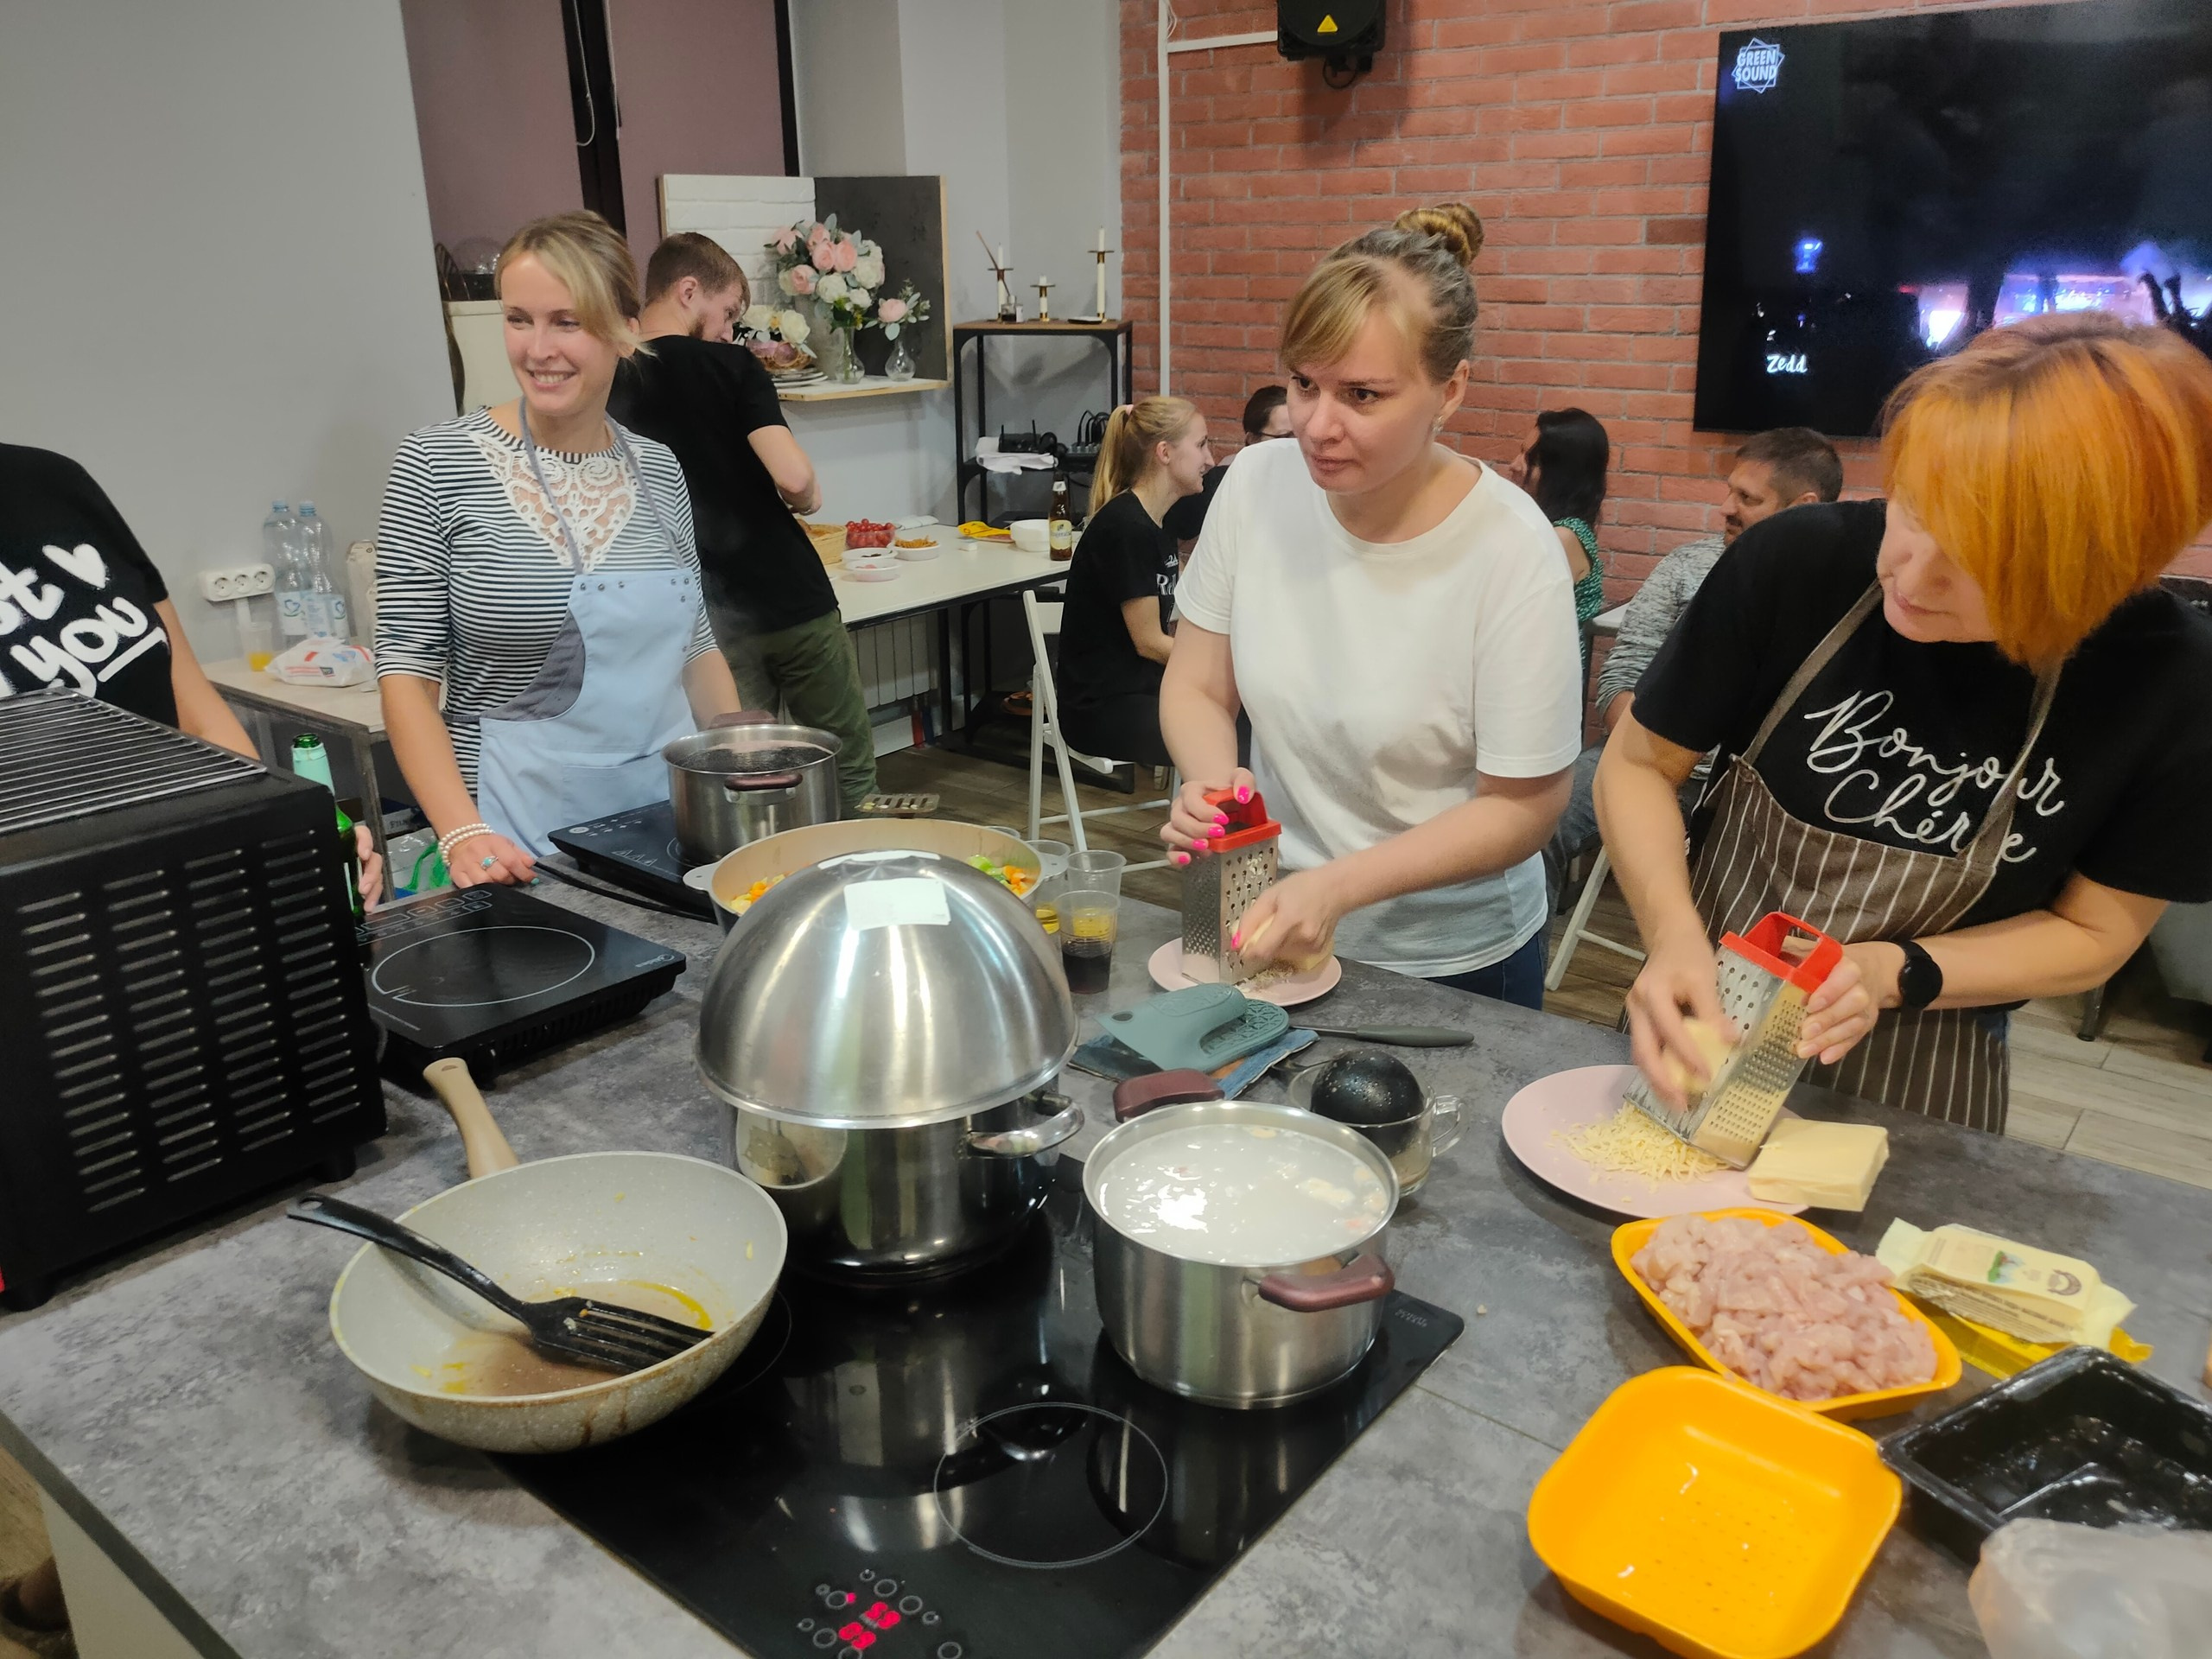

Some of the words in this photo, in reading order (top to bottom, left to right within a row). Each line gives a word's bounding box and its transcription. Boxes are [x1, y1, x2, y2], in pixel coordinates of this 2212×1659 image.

[1737, 49, 1776, 67] GREEN
[1735, 65, 1777, 82] SOUND
[1767, 354, 1808, 372] Zedd
[10, 596, 149, 697] you
